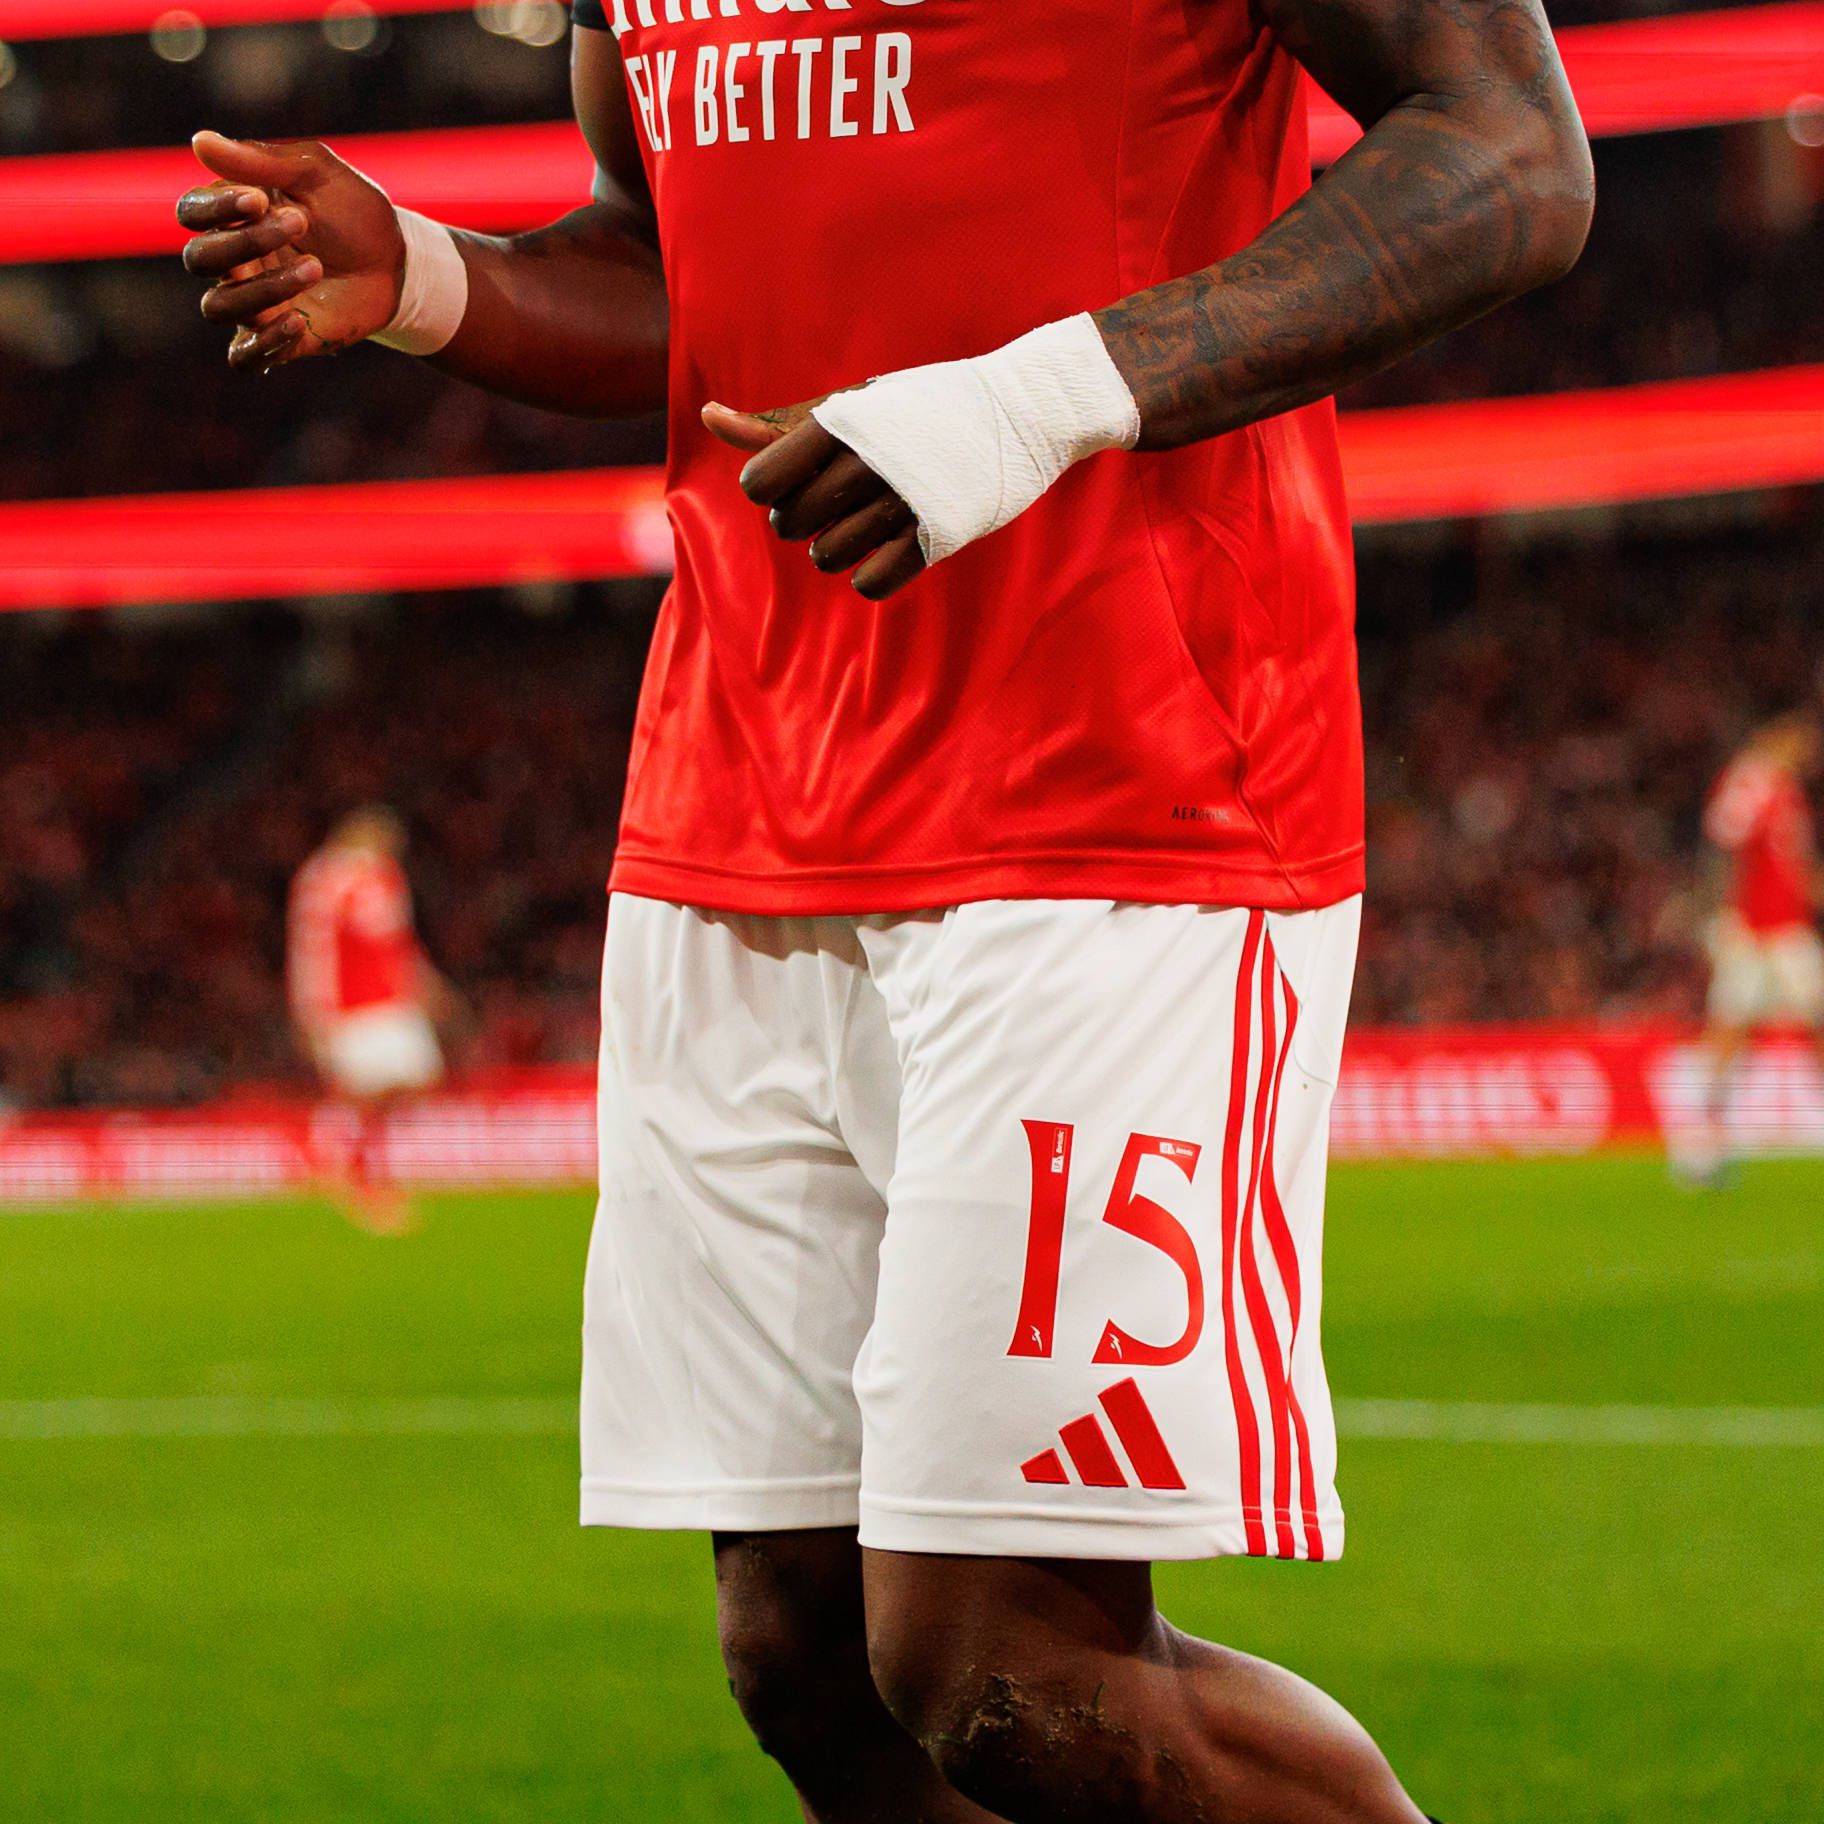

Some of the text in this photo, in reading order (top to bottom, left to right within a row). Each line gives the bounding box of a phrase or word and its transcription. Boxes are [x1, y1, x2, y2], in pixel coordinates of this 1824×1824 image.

[625, 31, 916, 152] FLY BETTER
[1005, 1118, 1205, 1367] 15
